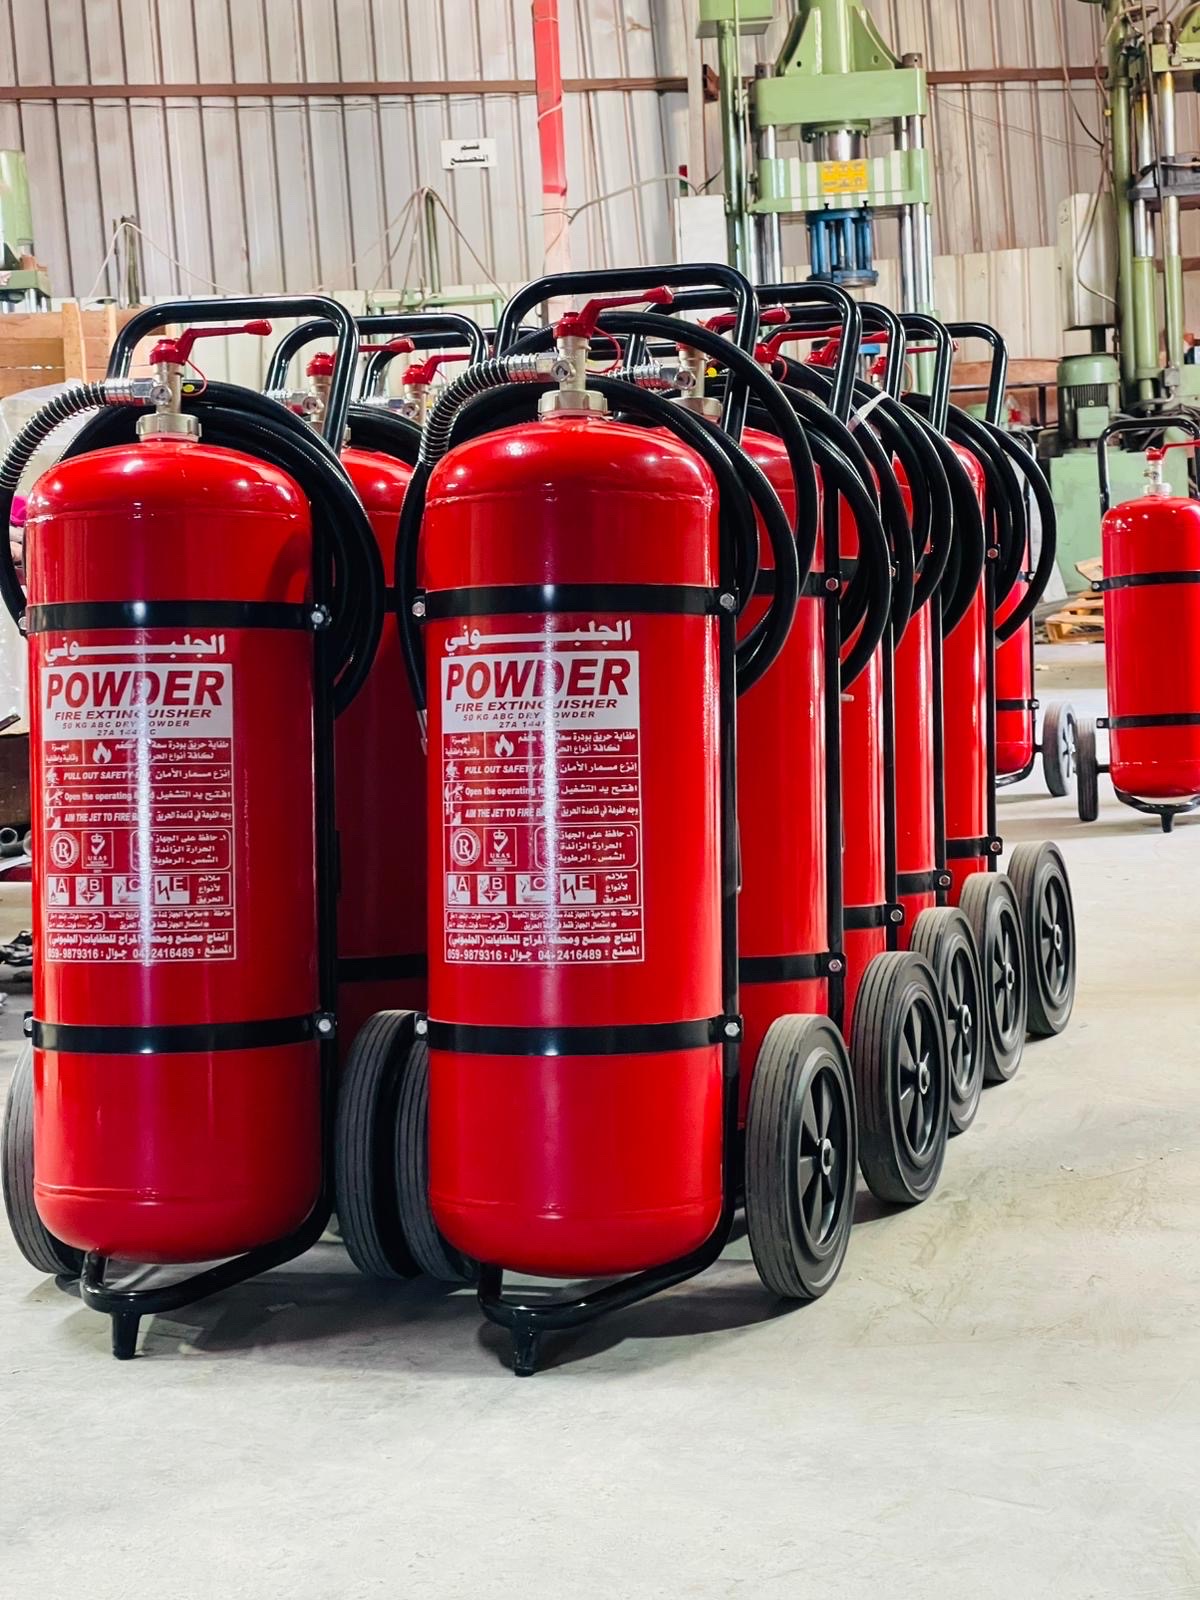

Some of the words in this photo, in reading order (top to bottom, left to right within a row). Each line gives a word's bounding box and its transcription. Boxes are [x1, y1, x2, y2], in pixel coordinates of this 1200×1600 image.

[446, 658, 631, 700] POWDER
[46, 670, 225, 709] POWDER
[455, 702, 482, 712] FIRE
[55, 711, 82, 721] FIRE
[542, 711, 595, 719] OWDER
[573, 732, 592, 742] بودرة
[593, 732, 613, 743] حريق
[168, 741, 186, 750] بودرة
[187, 741, 207, 750] حريق
[464, 766, 482, 774] PULL
[484, 765, 501, 774] OUT
[502, 765, 537, 773] SAFETY
[588, 762, 618, 773] مسمار
[64, 772, 81, 780] PULL
[82, 772, 99, 780] OUT
[100, 771, 133, 780] SAFETY
[182, 769, 212, 779] مسمار
[64, 792, 81, 802] Open
[82, 792, 93, 800] the
[95, 791, 132, 802] operating
[465, 787, 482, 797] Open
[484, 787, 495, 795] the
[497, 786, 536, 797] operating
[156, 811, 175, 821] الحريق
[478, 809, 490, 818] THE
[491, 808, 505, 818] JET
[506, 808, 515, 817] TO
[517, 808, 534, 817] FIRE
[561, 806, 581, 817] الحريق
[76, 813, 88, 822] THE
[89, 813, 102, 822] JET
[103, 813, 113, 821] TO
[114, 813, 130, 821] FIRE
[198, 833, 218, 841] حافظ
[586, 830, 603, 839] على
[604, 829, 625, 837] حافظ
[180, 835, 196, 843] على
[186, 845, 215, 854] الحرارة
[592, 842, 622, 850] الحرارة
[191, 854, 218, 865] الشمس
[597, 852, 626, 862] الشمس
[57, 879, 67, 893] A
[90, 879, 100, 891] B
[173, 877, 184, 891] E
[458, 876, 468, 891] A
[492, 877, 503, 890] B
[580, 875, 590, 890] E
[196, 896, 224, 905] الحريق
[602, 894, 632, 904] الحريق
[175, 933, 203, 945] مصنع
[582, 934, 611, 946] مصنع
